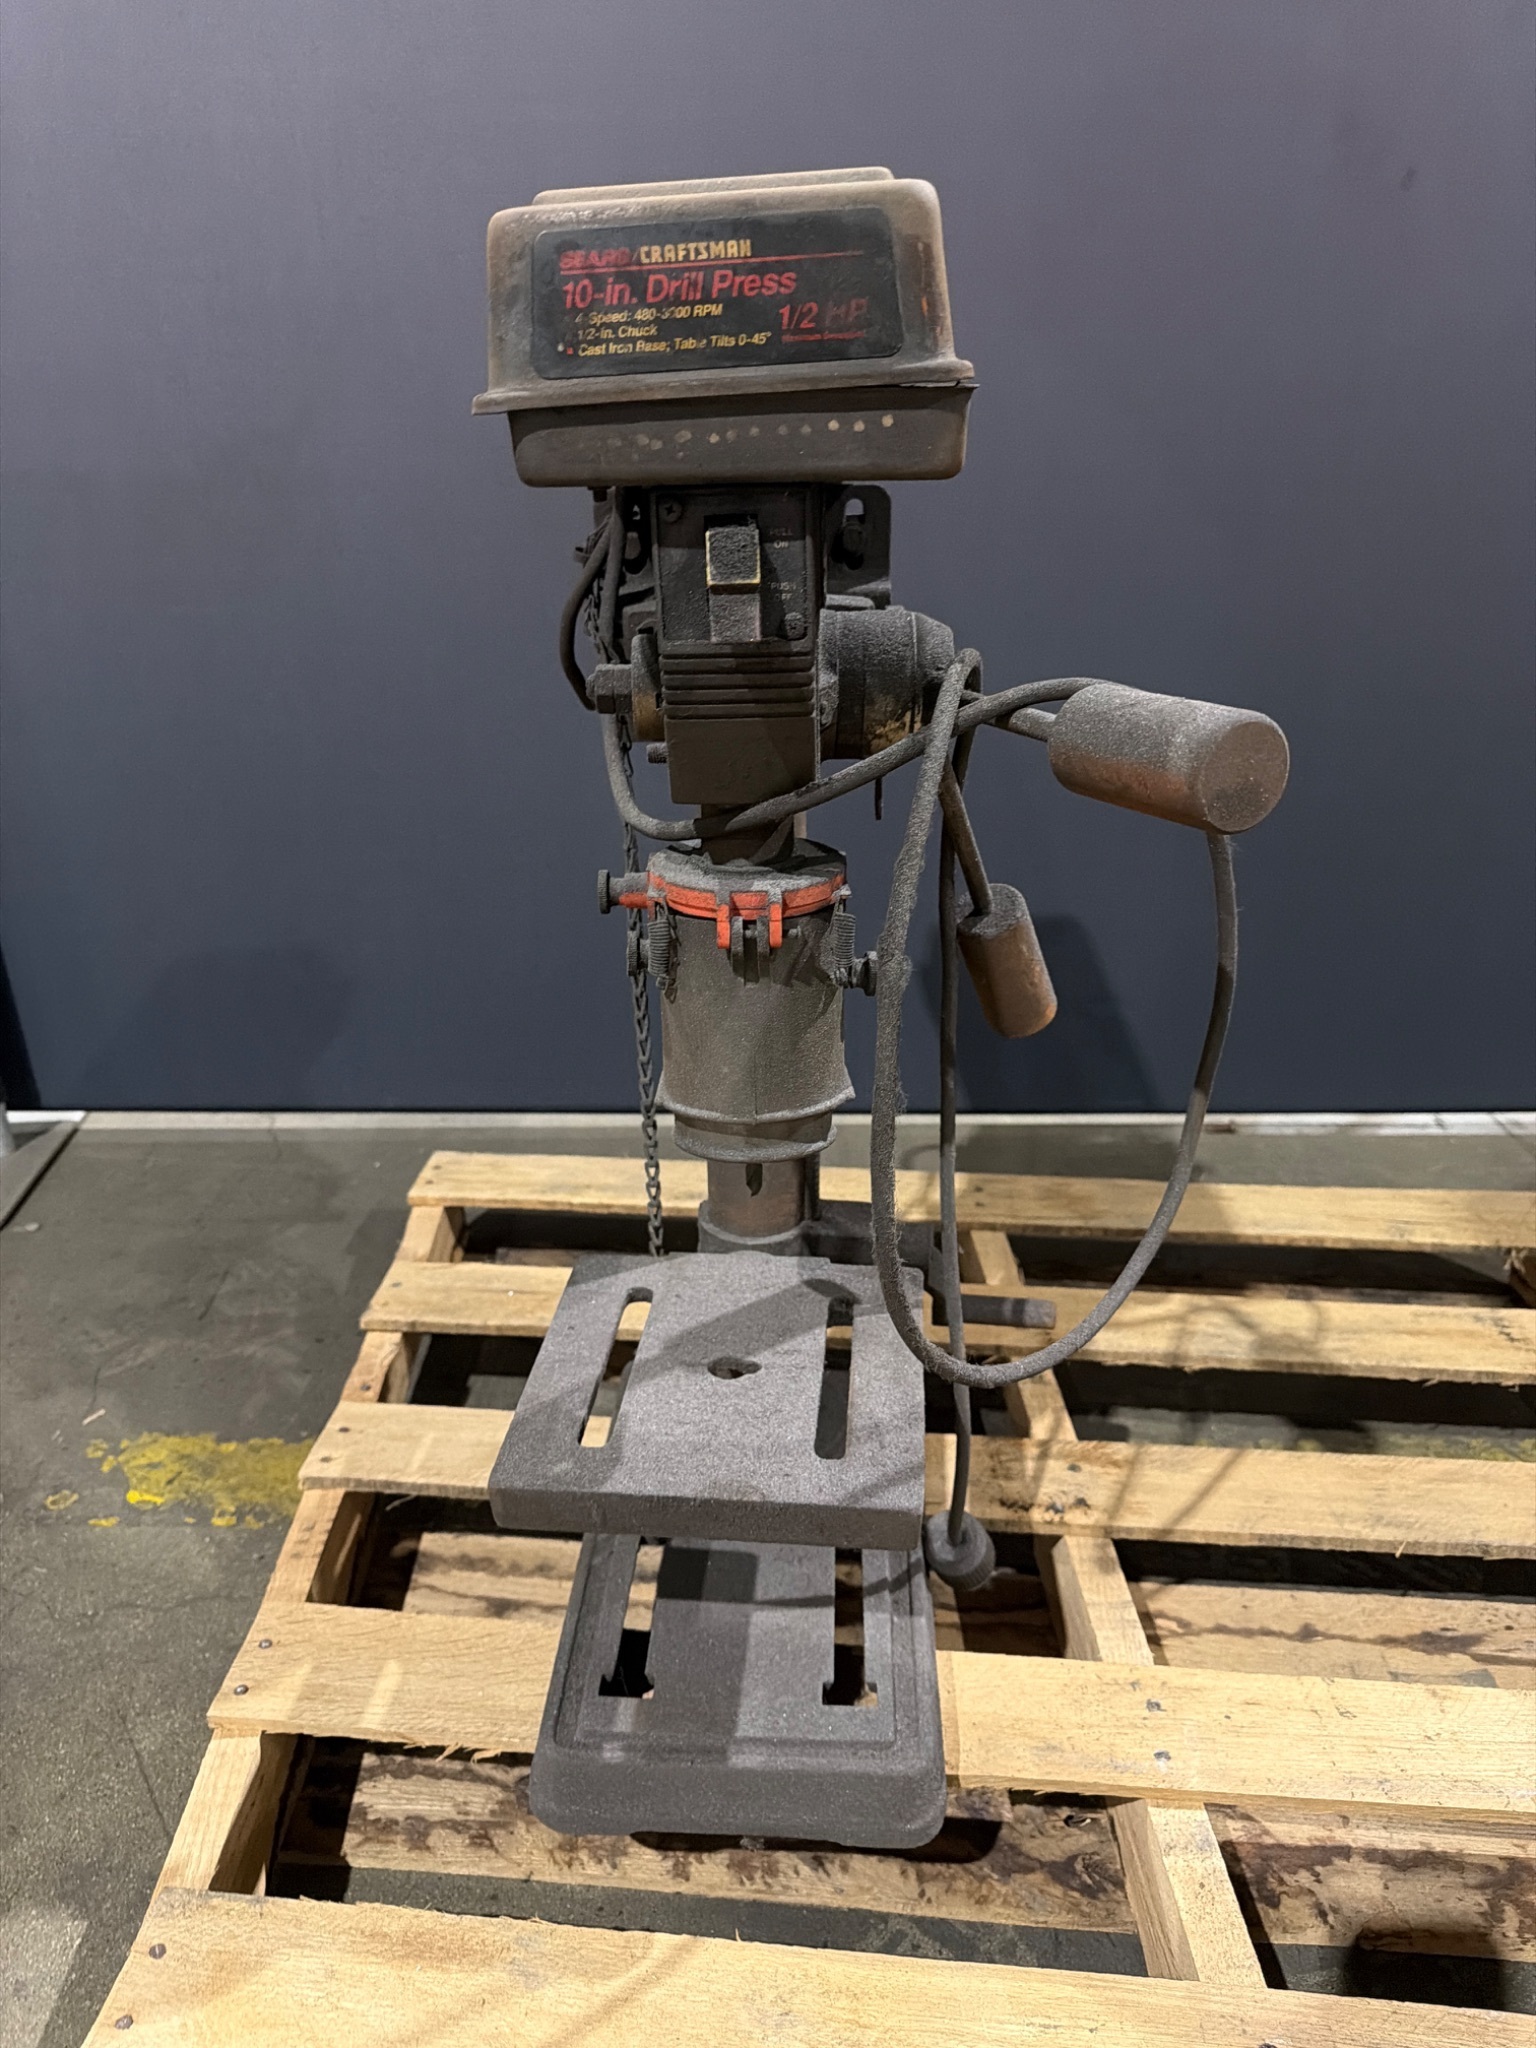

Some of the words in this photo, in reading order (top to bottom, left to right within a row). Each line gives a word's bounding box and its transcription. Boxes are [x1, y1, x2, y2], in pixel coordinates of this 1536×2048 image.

[639, 239, 752, 264] CRAFTSMAN
[563, 276, 638, 309] 10-in.
[646, 271, 705, 303] Drill
[711, 269, 797, 299] Press
[692, 303, 723, 317] RPM
[779, 301, 819, 330] 1/2
[617, 324, 658, 338] Chuck
[578, 342, 606, 357] Cast
[608, 341, 633, 354] Iron
[710, 335, 736, 348] Tilts
